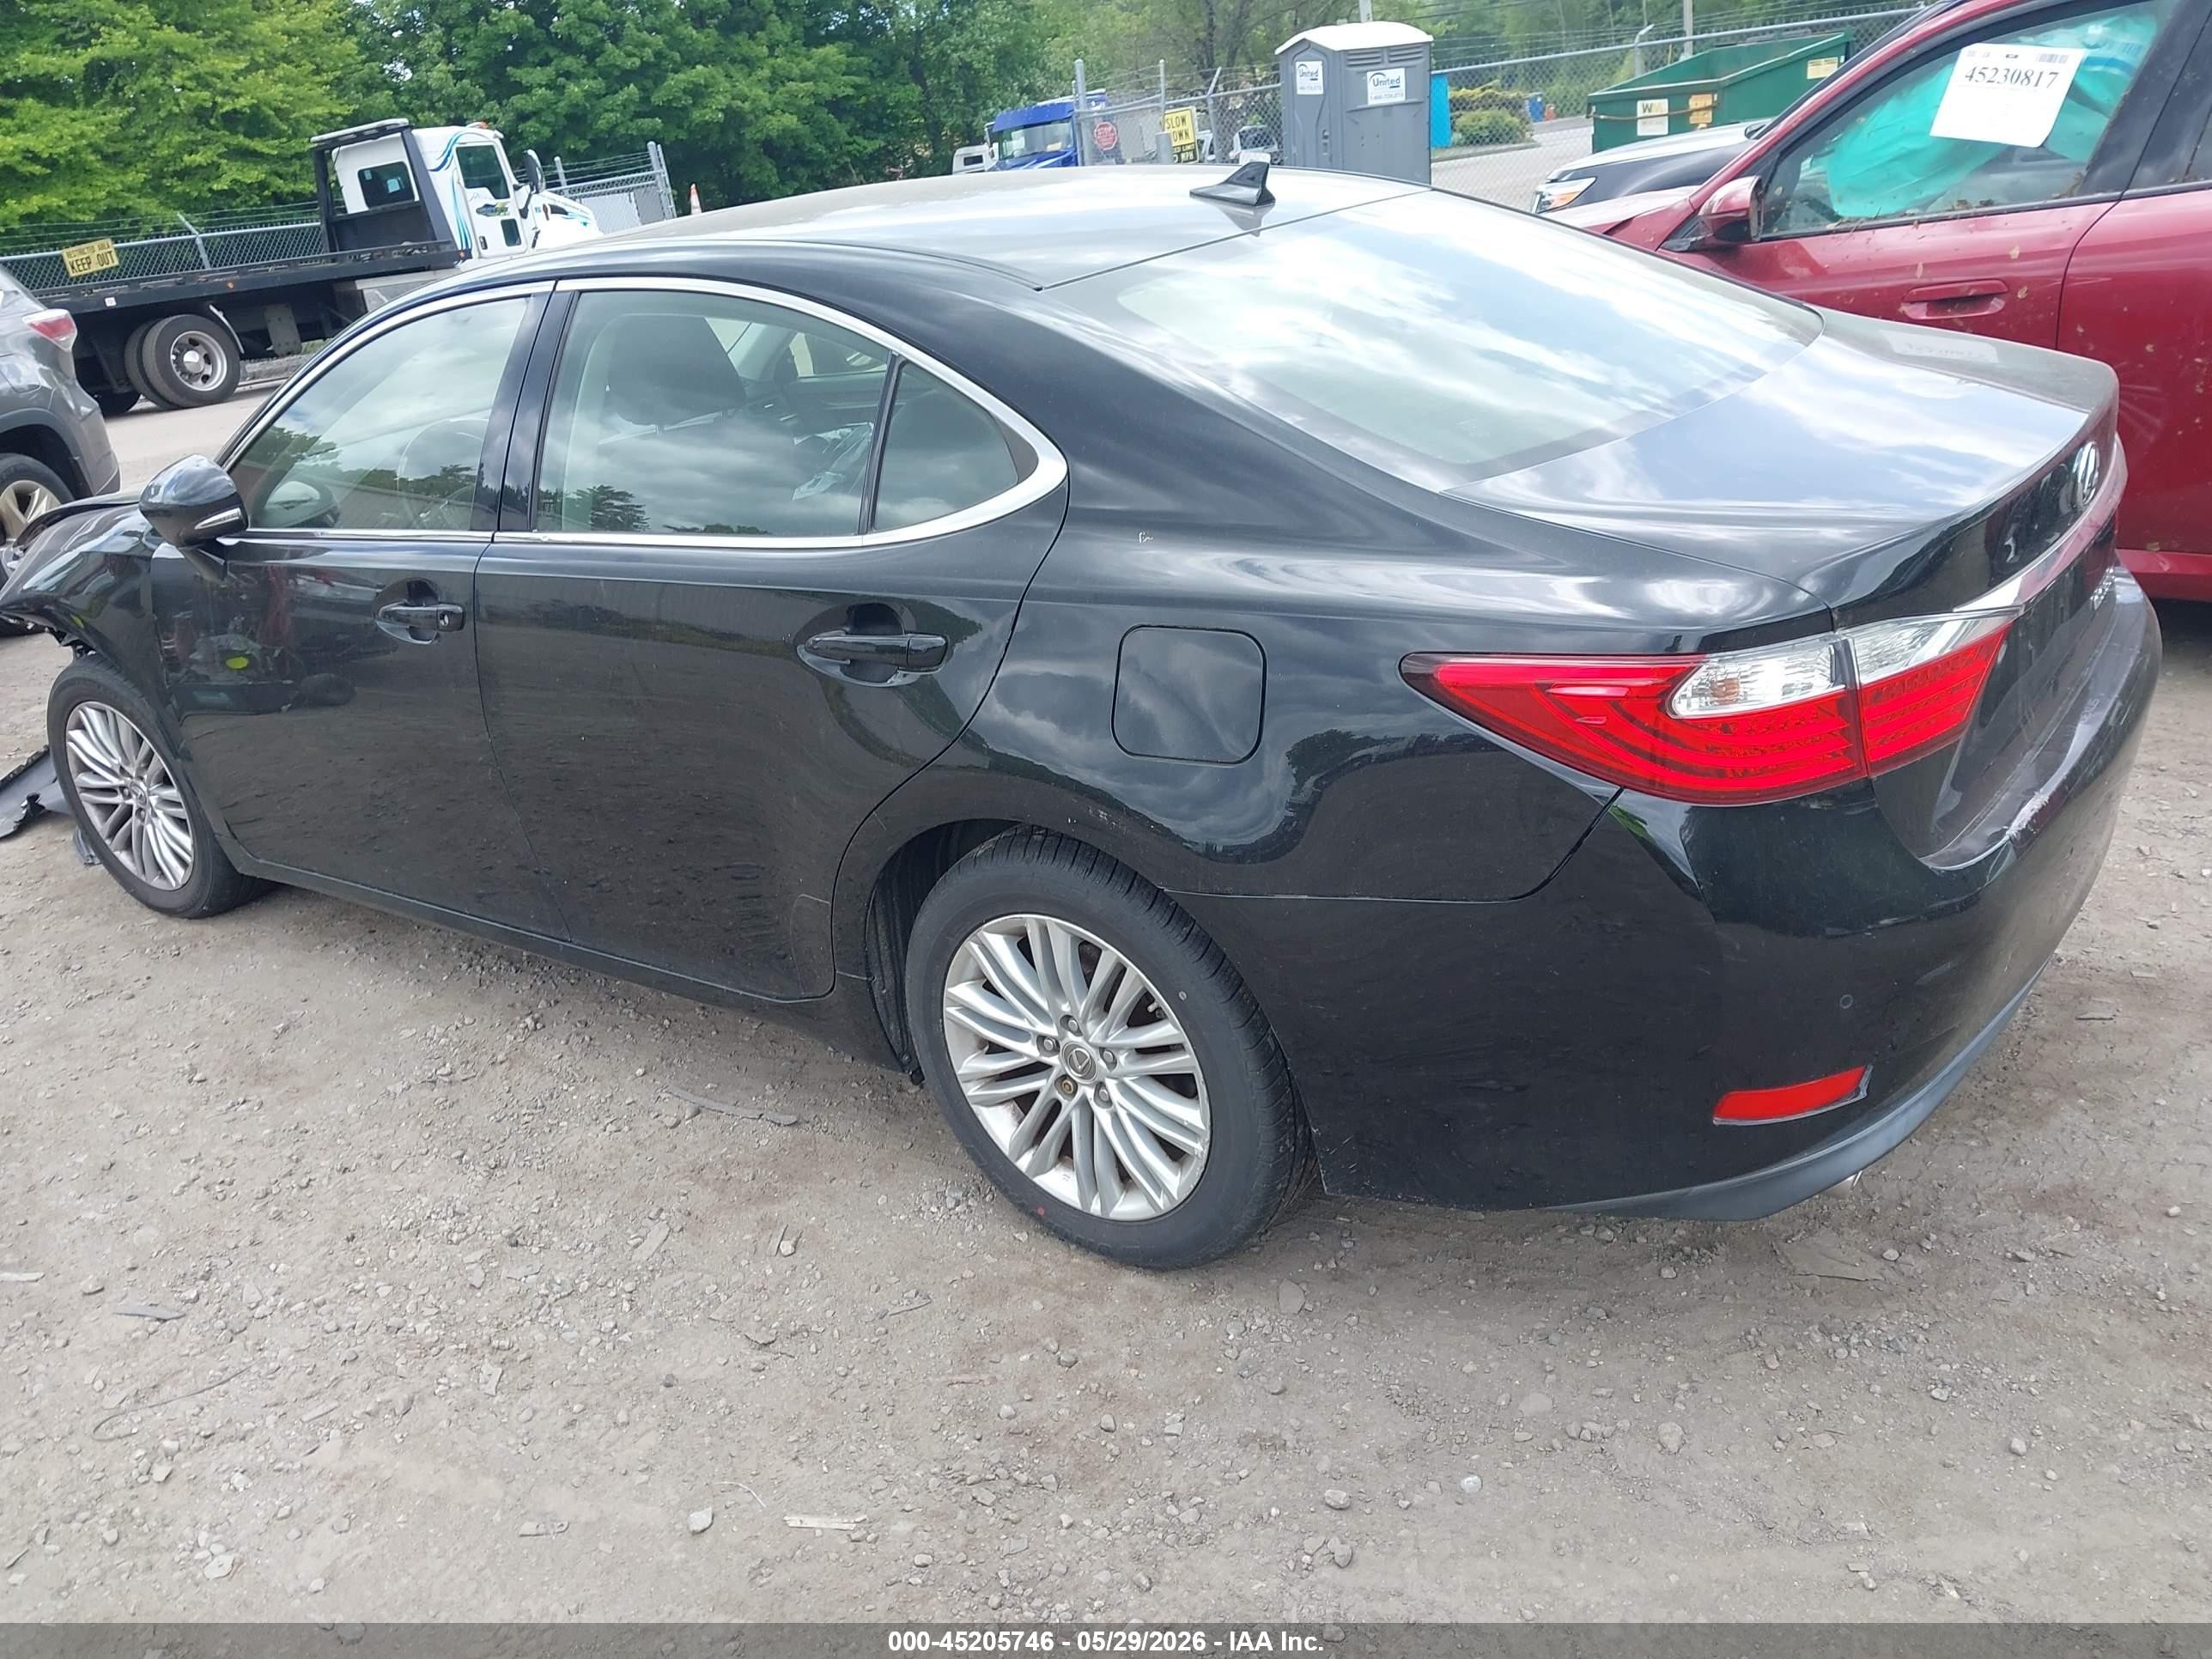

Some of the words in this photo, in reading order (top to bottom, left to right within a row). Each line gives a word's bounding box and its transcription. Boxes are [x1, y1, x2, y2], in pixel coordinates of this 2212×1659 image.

[1372, 75, 1401, 87] United
[1964, 65, 2060, 88] 45230817
[1166, 114, 1188, 130] SLOW
[1172, 128, 1190, 143] OWN
[69, 256, 92, 274] KEEP
[96, 250, 115, 267] OUT
